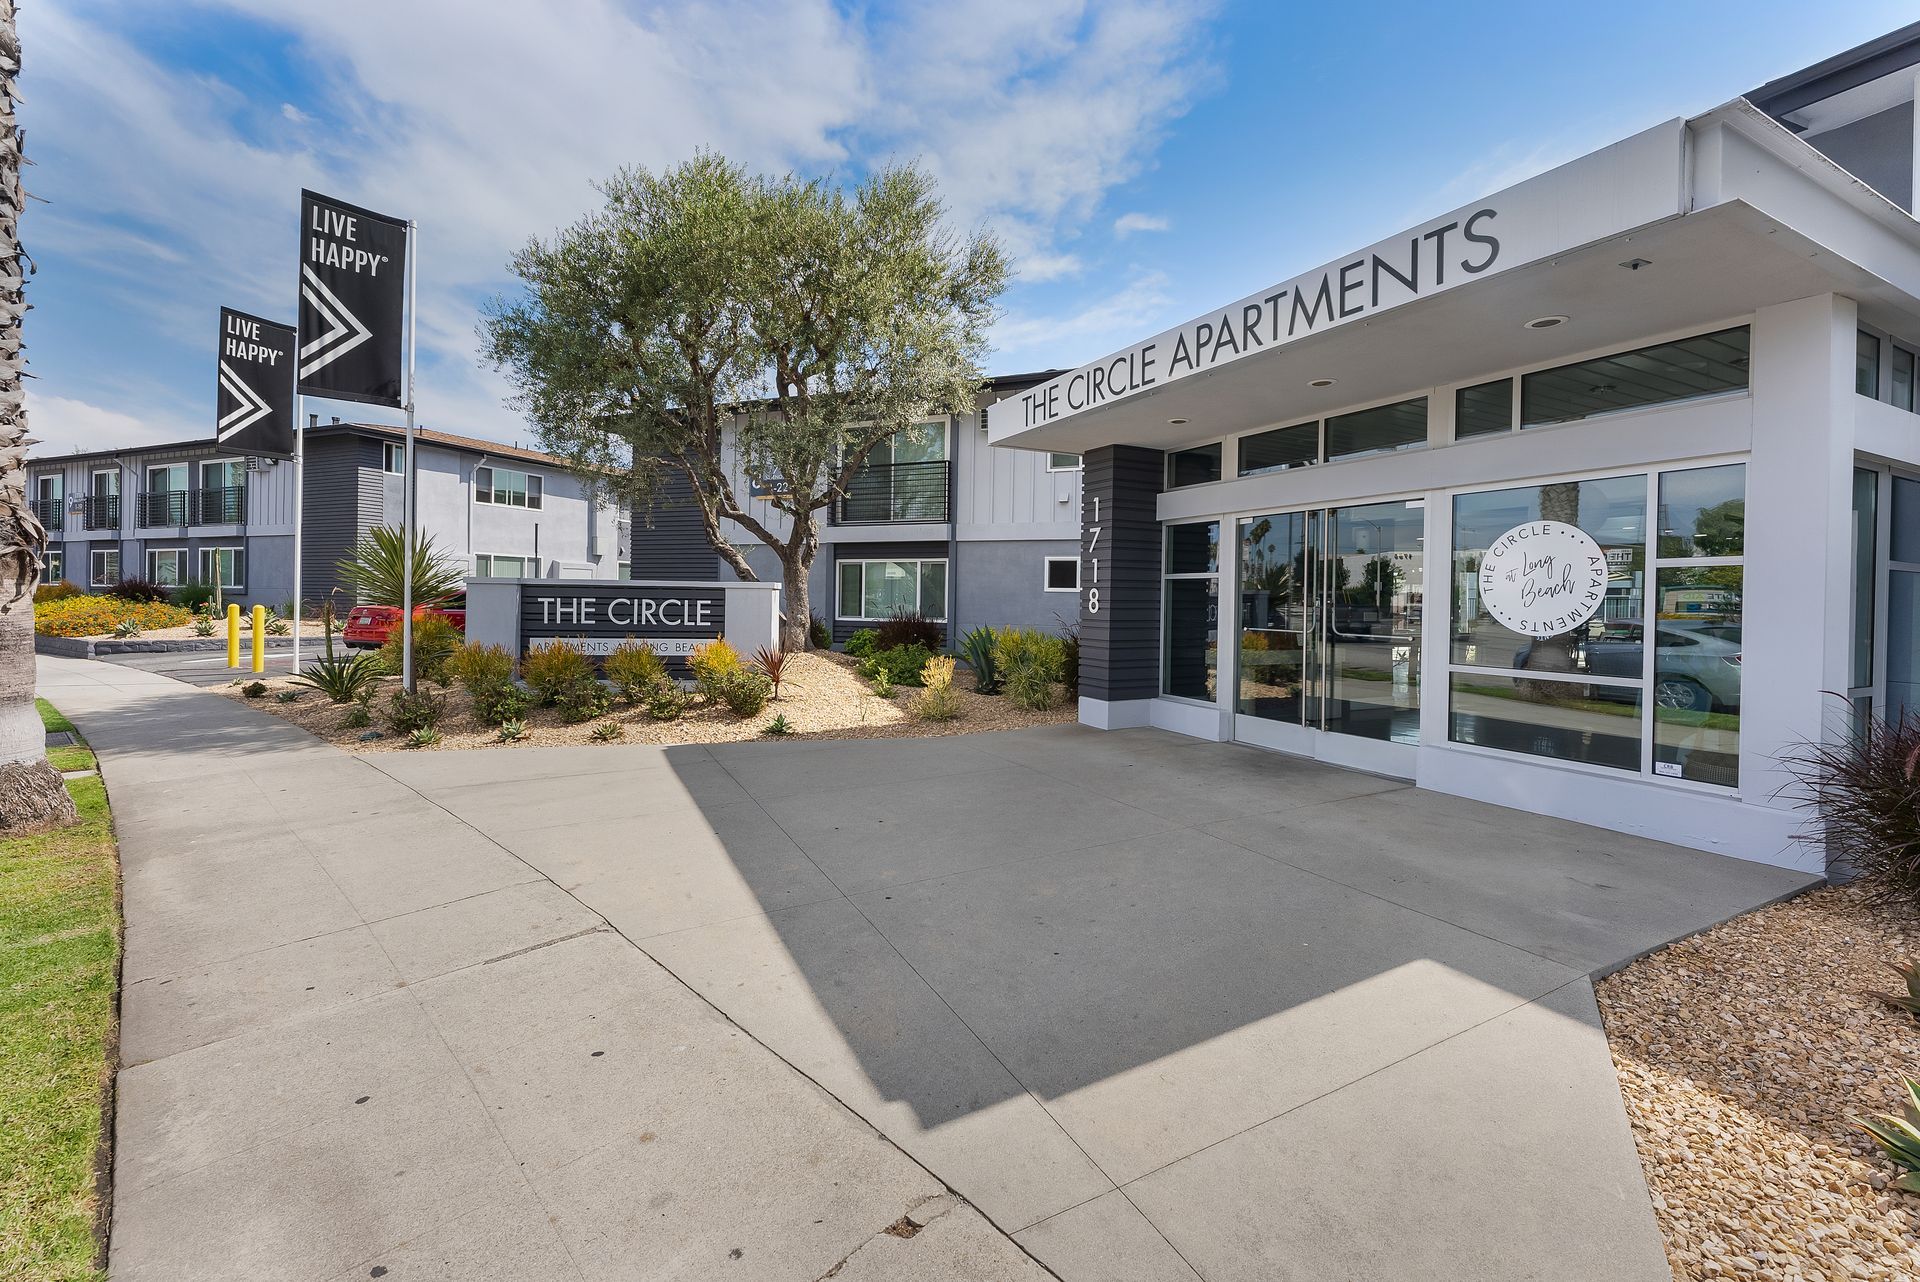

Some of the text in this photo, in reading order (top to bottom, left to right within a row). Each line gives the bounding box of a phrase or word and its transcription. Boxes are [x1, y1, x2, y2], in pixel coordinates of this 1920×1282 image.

[312, 205, 357, 242] LIVE
[227, 315, 260, 341] LIVE
[1022, 208, 1501, 427] THE CIRCLE APARTMENTS
[1088, 497, 1101, 614] 1718
[1483, 525, 1551, 594] THE CIRCLE
[1522, 551, 1556, 579] Long
[1505, 568, 1518, 582] at
[1521, 563, 1576, 608] Beach
[538, 597, 712, 626] THE CIRCLE
[1519, 556, 1603, 632] APARTMENTS
[537, 642, 609, 652] APTMENTS
[675, 642, 709, 652] BEAC
